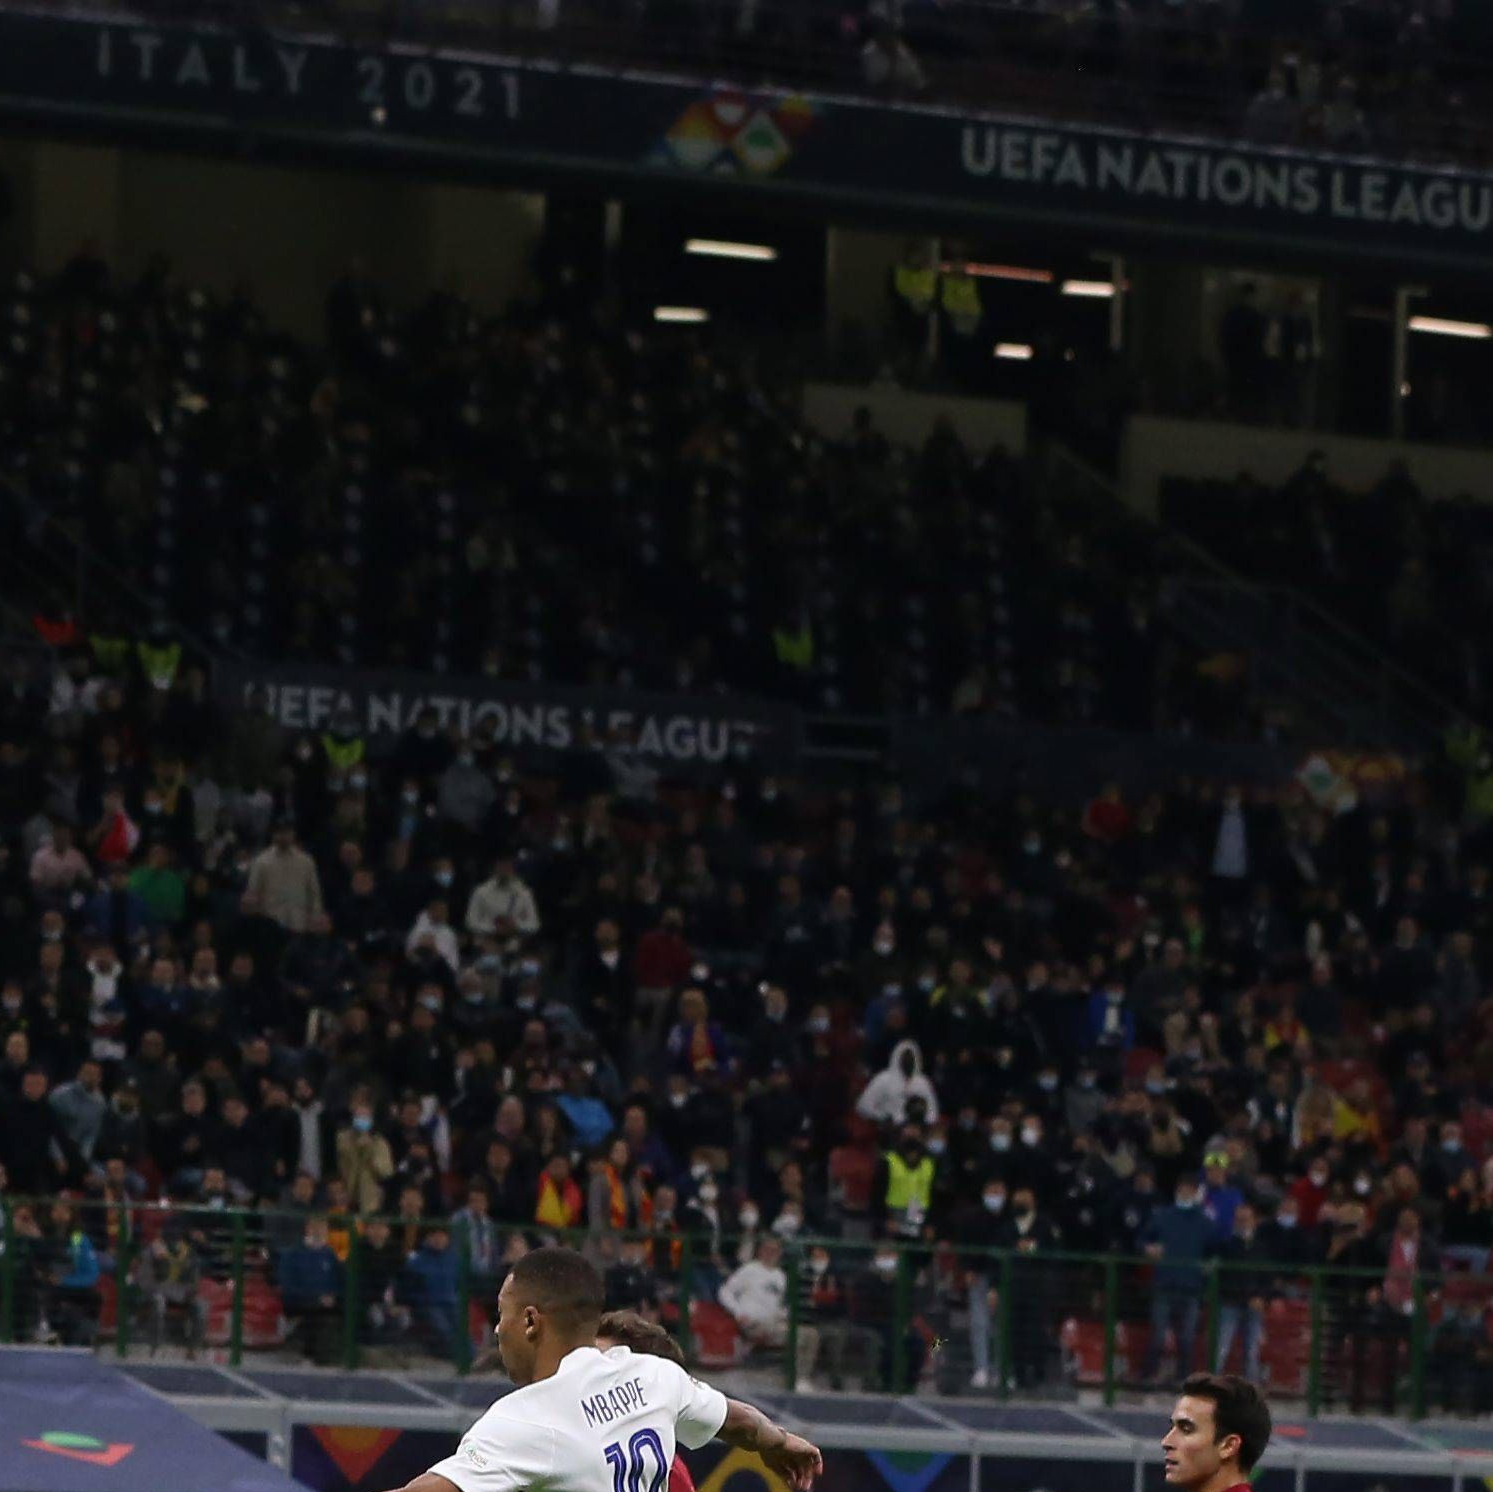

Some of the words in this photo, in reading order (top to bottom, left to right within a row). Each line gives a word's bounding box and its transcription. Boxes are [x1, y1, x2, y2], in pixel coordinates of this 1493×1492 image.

[97, 31, 309, 95] ITALY
[356, 55, 522, 119] 2021
[961, 126, 1089, 190] UEFA
[1096, 144, 1318, 216] NATIONS
[1330, 169, 1493, 232] LEAGU
[580, 1376, 648, 1428] MBAPPE
